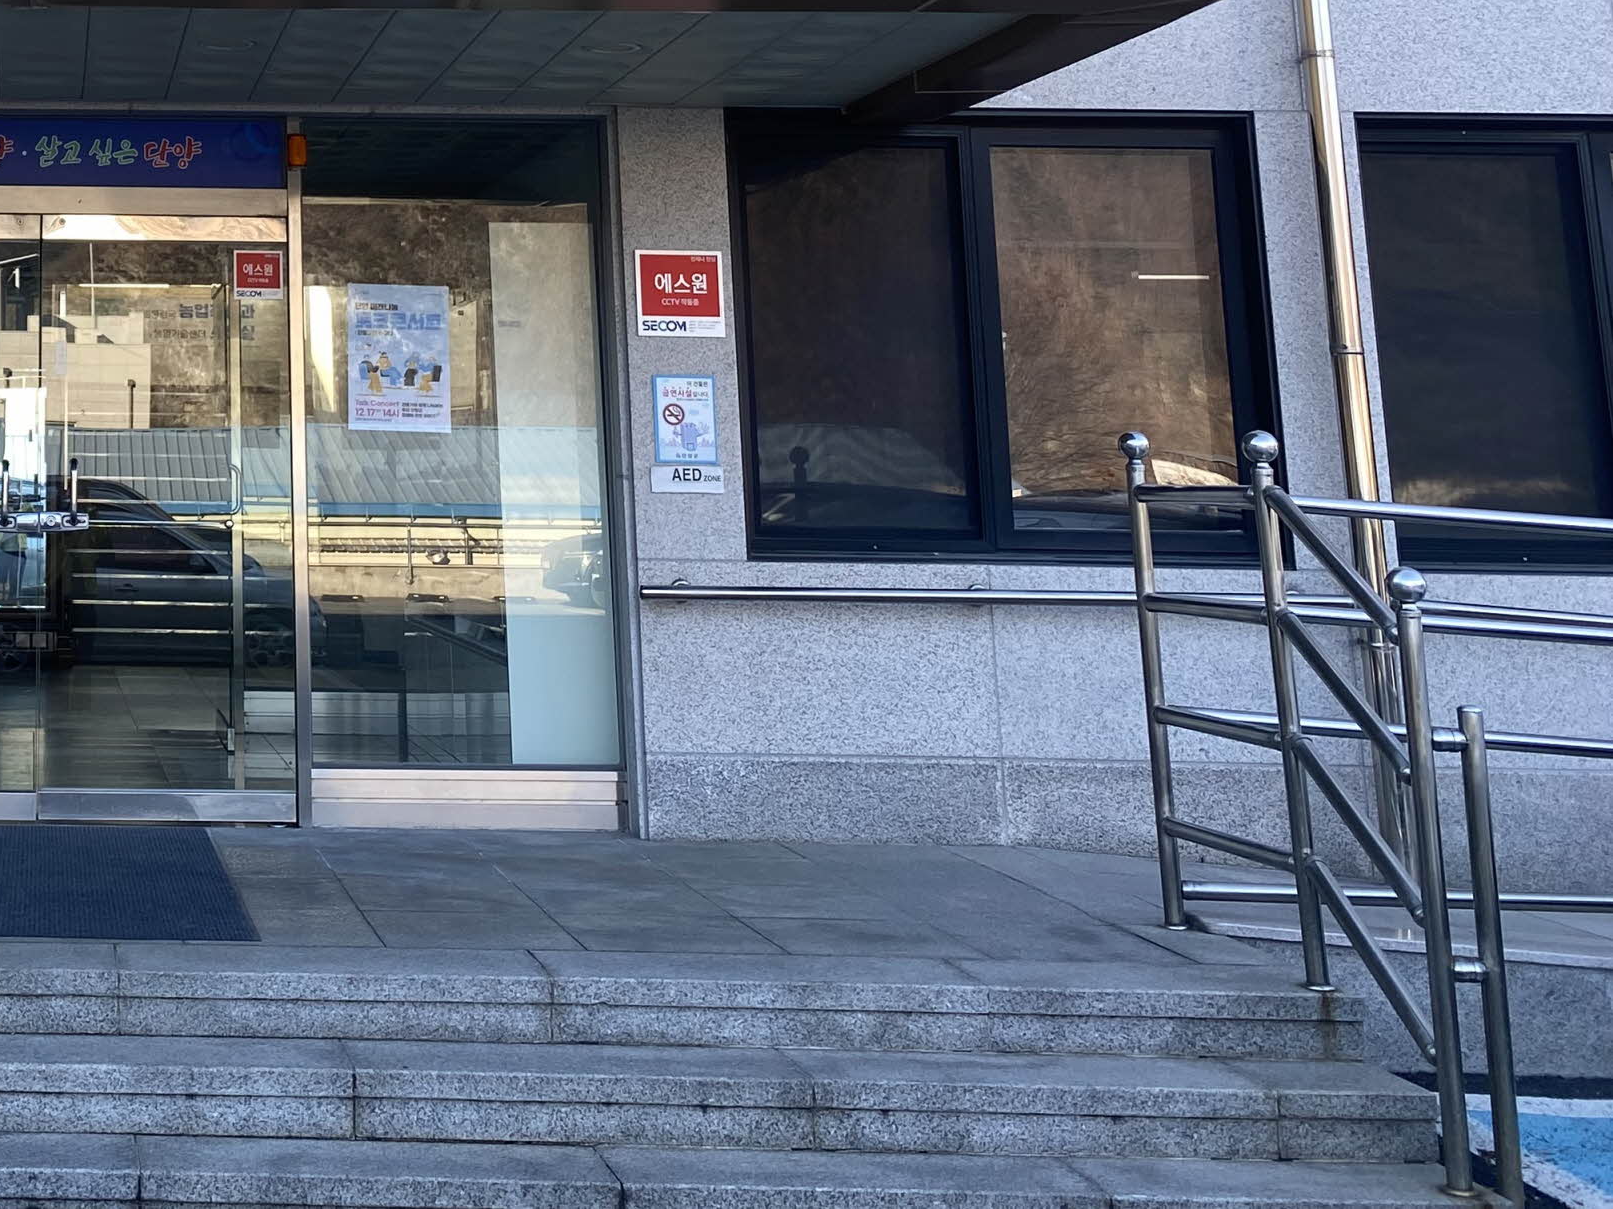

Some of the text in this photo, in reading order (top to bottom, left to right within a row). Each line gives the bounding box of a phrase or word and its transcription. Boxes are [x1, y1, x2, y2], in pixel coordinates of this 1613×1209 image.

[35, 136, 81, 167] 살고
[89, 139, 137, 166] 싶은
[144, 135, 202, 169] 단양
[243, 263, 273, 276] 에스원
[654, 273, 707, 294] 에스원
[642, 320, 687, 331] SECOM
[672, 468, 702, 481] AED
